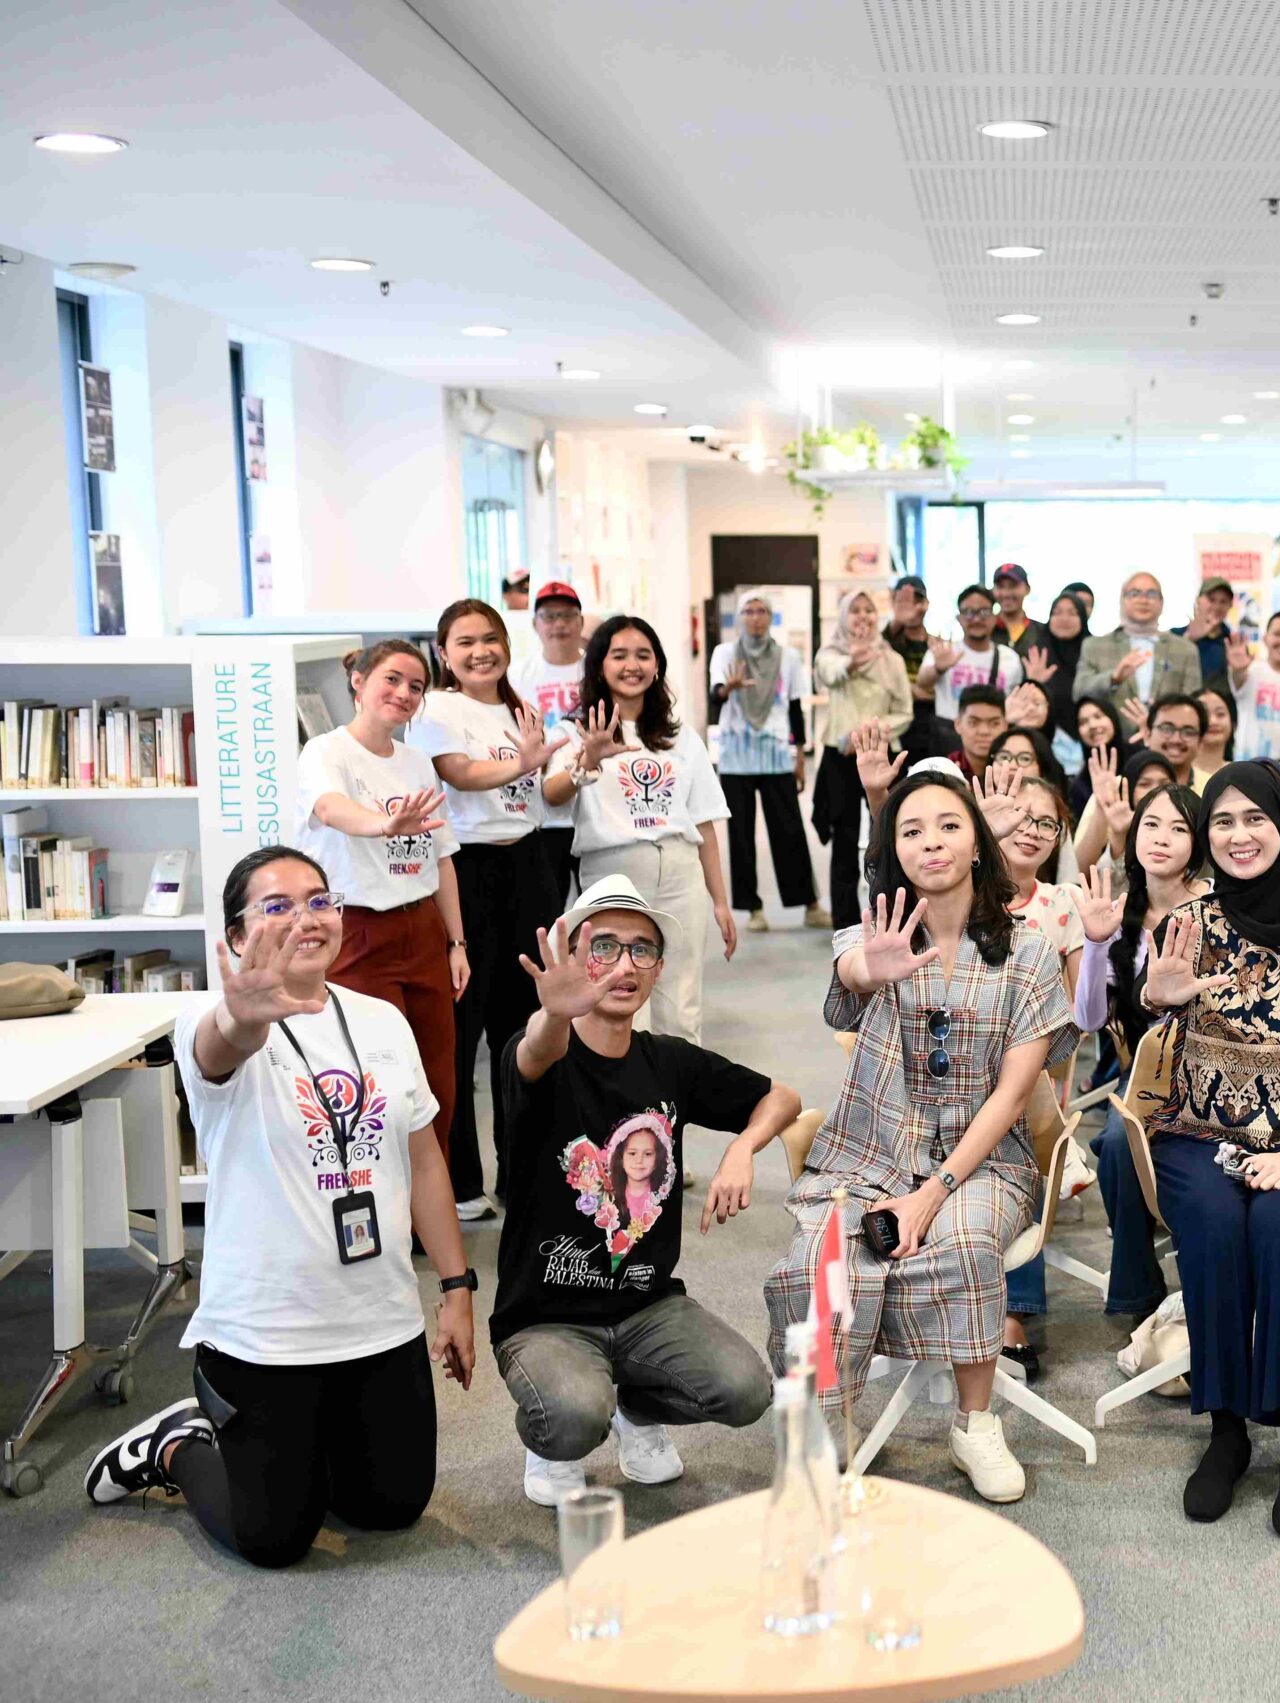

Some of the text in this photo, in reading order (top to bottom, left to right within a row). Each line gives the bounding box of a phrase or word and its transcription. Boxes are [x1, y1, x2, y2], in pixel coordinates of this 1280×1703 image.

[214, 663, 243, 833] LITTERATURE
[251, 662, 281, 847] ESUSASTRAAN
[317, 1168, 372, 1192] FRENSHE
[873, 1217, 894, 1246] 11.35
[539, 1234, 602, 1260] Hind
[547, 1255, 589, 1274] RAJAB
[543, 1269, 615, 1290] PALESTINA
